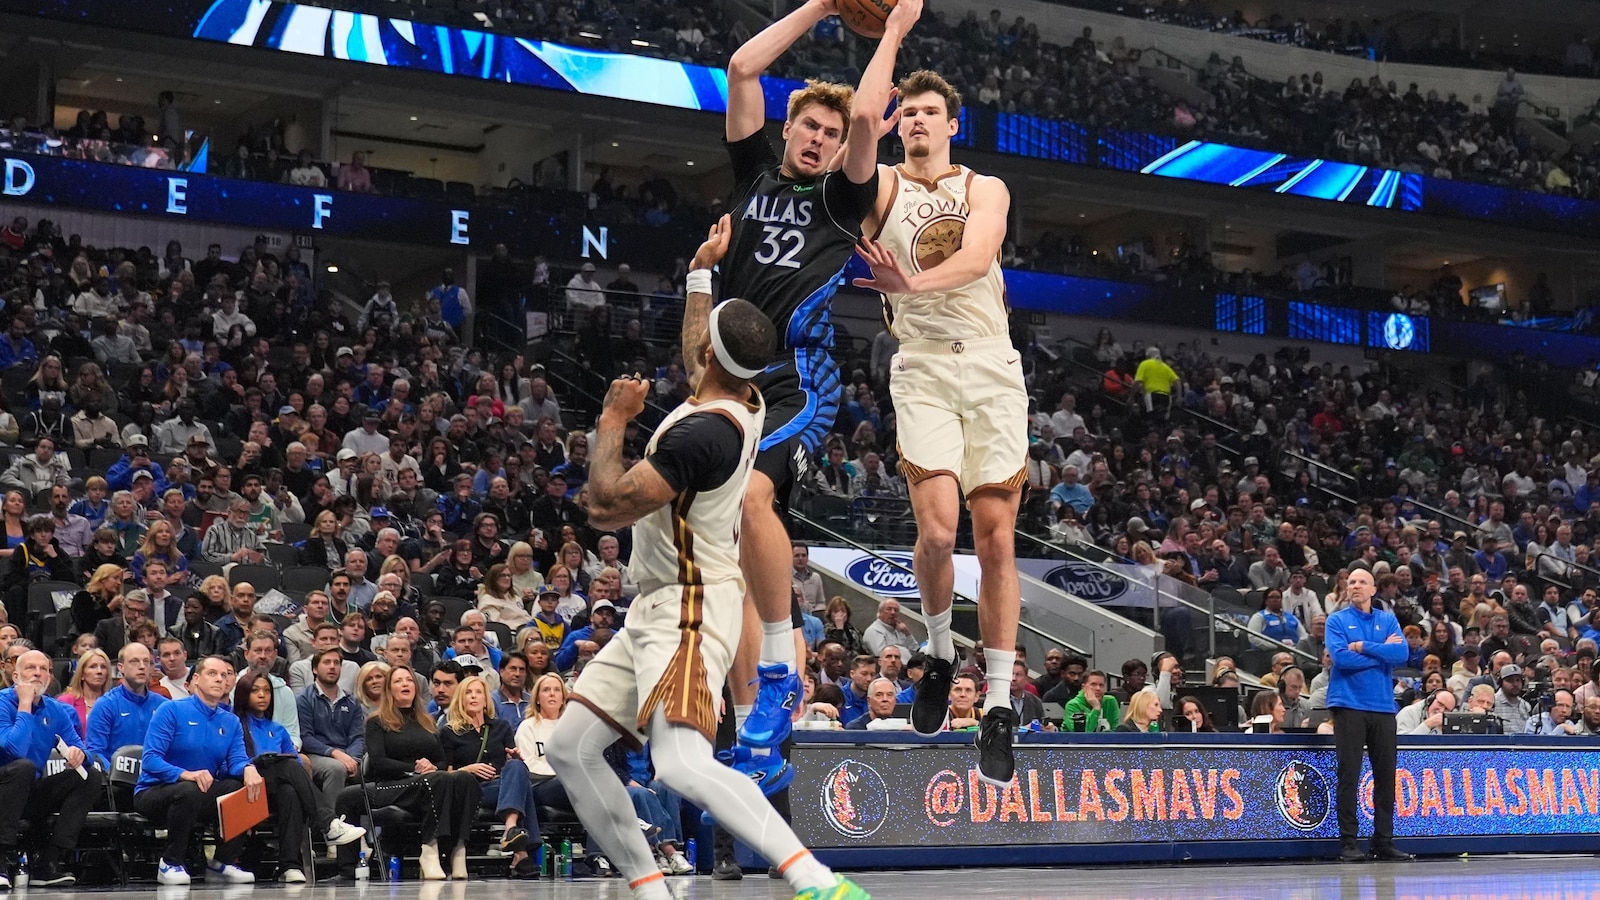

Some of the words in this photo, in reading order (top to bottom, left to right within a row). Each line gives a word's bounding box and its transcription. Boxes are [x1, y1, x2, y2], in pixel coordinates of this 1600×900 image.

[903, 200, 919, 213] The
[754, 225, 805, 269] 32
[115, 755, 138, 774] GET
[924, 768, 1245, 827] @DALLASMAVS
